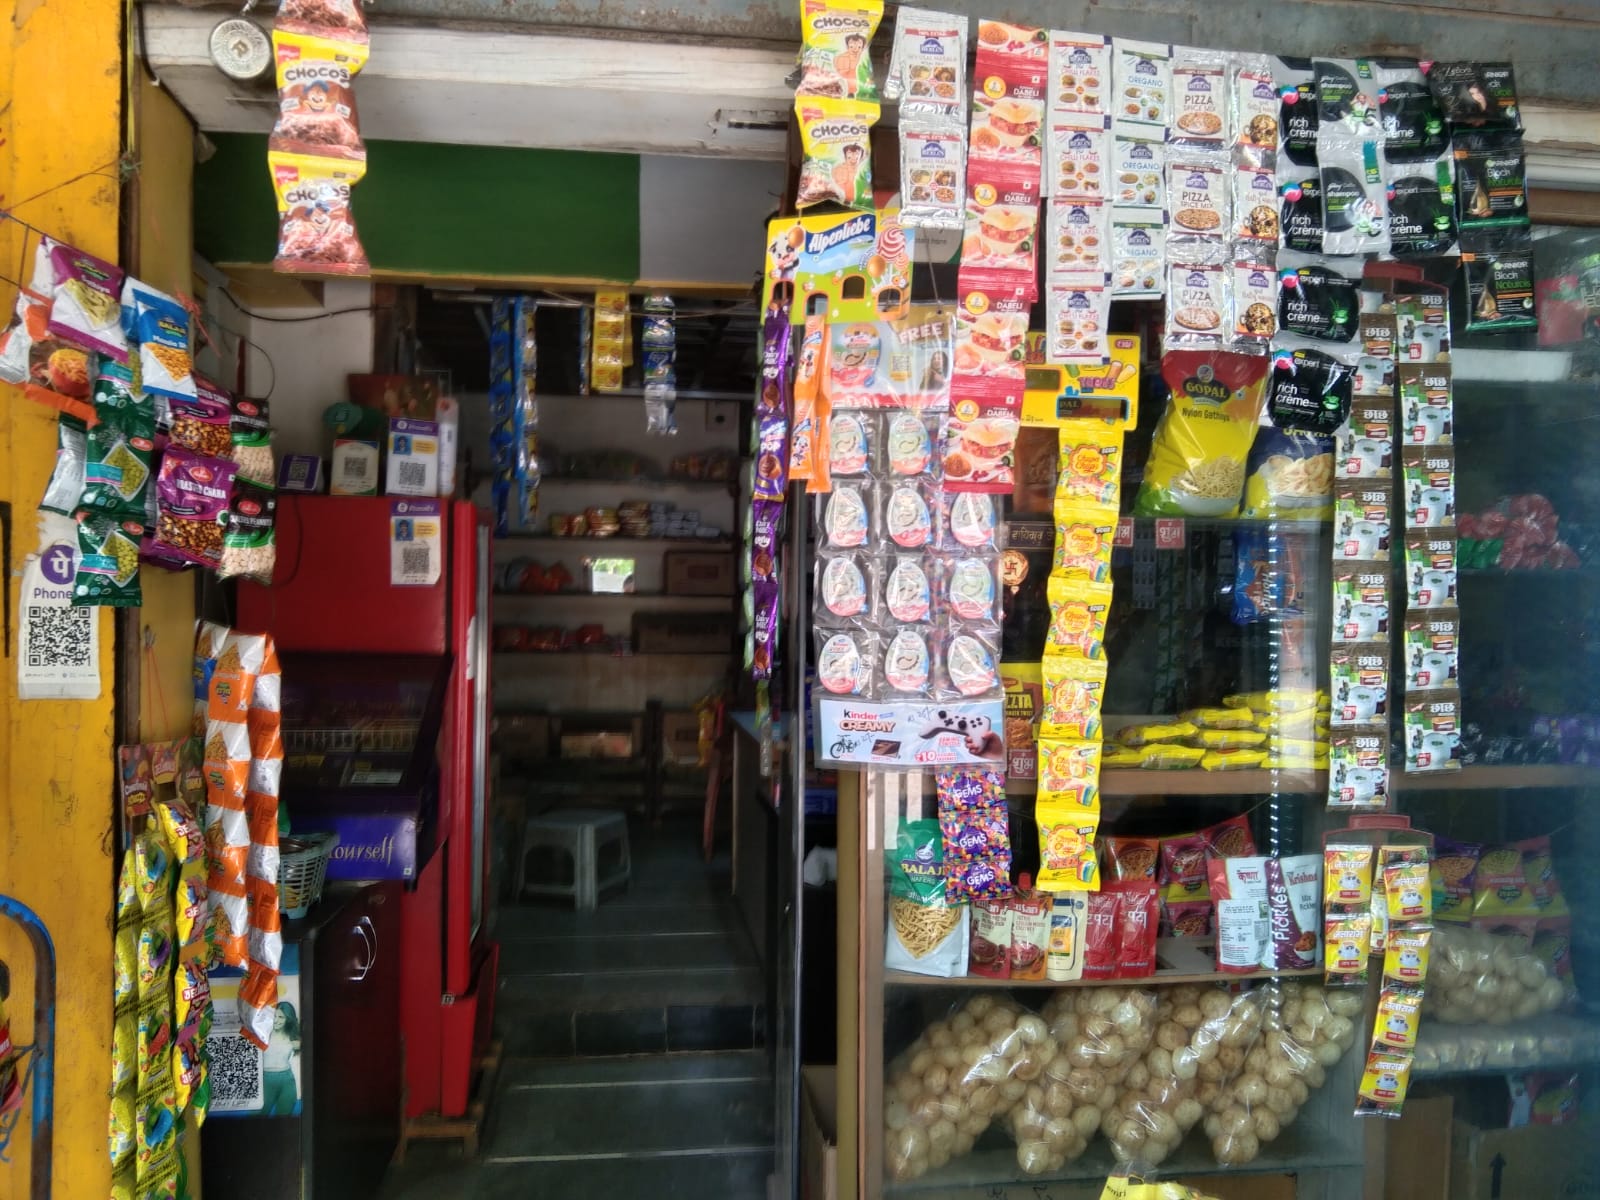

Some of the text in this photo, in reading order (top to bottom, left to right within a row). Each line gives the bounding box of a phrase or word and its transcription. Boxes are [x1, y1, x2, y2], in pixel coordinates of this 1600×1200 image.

[813, 17, 870, 29] CHOCOS
[286, 67, 350, 83] CHOCOS
[1128, 76, 1163, 87] OREGANO
[1013, 87, 1039, 97] DABELI
[1184, 95, 1214, 105] PIZZA
[1289, 116, 1309, 127] rich
[811, 124, 868, 138] CHOCOS
[1122, 162, 1159, 171] OREGANO
[1005, 194, 1031, 203] DABELI
[1182, 190, 1211, 203] PIZZA
[1292, 214, 1311, 225] rich
[1390, 215, 1409, 224] rich
[808, 218, 871, 253] Alpenliebe
[1293, 225, 1324, 237] crème
[1391, 225, 1423, 235] crème
[1300, 275, 1325, 286] expert
[1182, 289, 1212, 300] PIZZA
[996, 301, 1023, 310] DABELI
[1287, 300, 1308, 312] rich
[1287, 311, 1320, 324] crème
[899, 322, 945, 342] FREE
[1294, 357, 1320, 368] expert
[1186, 382, 1227, 398] GOPAL
[1277, 383, 1298, 395] rich
[1276, 395, 1310, 407] crème
[1182, 407, 1203, 419] Nylon
[760, 441, 782, 453] POP
[202, 487, 227, 499] CHANA
[50, 550, 72, 579] पे
[34, 588, 73, 599] Phone
[843, 709, 878, 721] kinder
[841, 720, 896, 733] CREAMY
[1012, 757, 1034, 773] शुभ
[955, 784, 983, 798] GEMS
[959, 834, 988, 848] GEMS
[967, 871, 995, 886] GEMS
[1289, 873, 1318, 886] Krishna
[1273, 886, 1290, 941] Pickles
